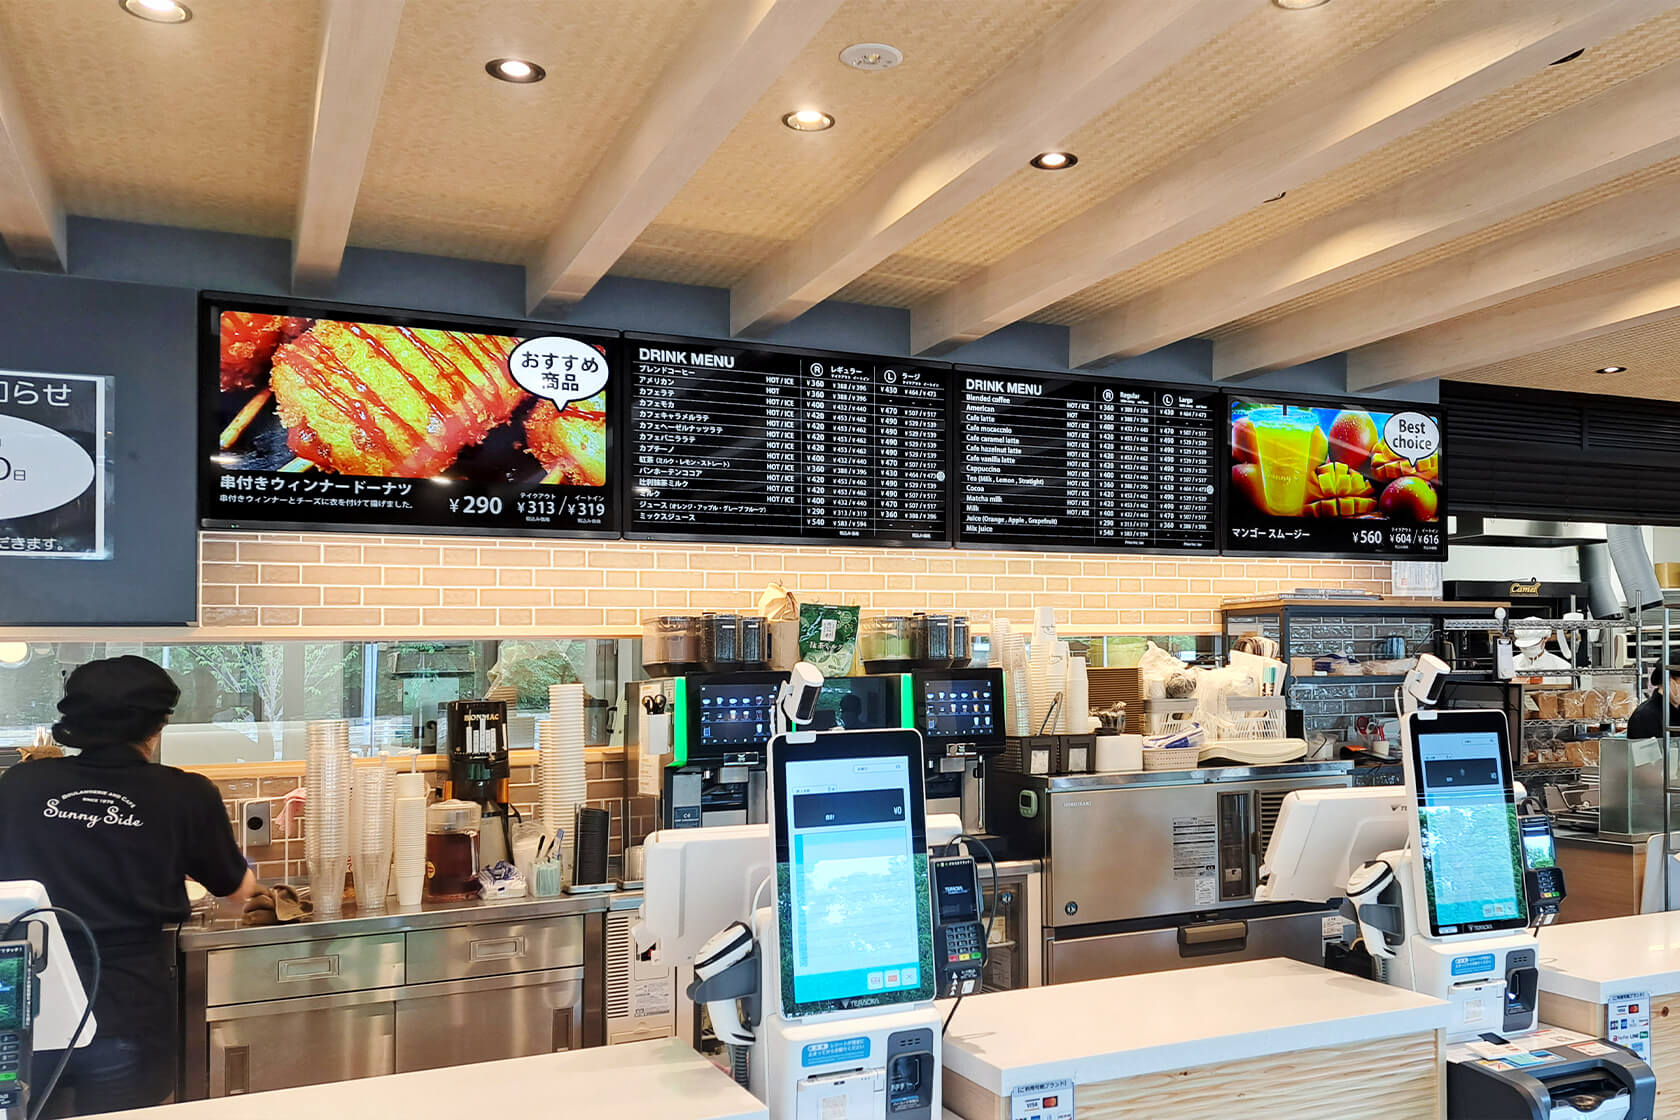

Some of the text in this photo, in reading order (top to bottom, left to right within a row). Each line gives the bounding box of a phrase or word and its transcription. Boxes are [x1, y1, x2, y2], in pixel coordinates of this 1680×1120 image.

[521, 351, 599, 373] おすすめ
[639, 348, 735, 369] DRINK MENU
[639, 365, 695, 375] ブレンドコーヒー
[831, 366, 863, 375] レギュラー
[902, 372, 920, 381] ラージ
[541, 371, 579, 392] 商品
[639, 376, 675, 386] アメリカン
[639, 387, 675, 397] カフェラテ
[766, 387, 780, 395] HOT
[966, 378, 1042, 396] DRINK MENU
[639, 399, 675, 408] カフェモカ
[966, 394, 1011, 404] Blended coffee
[966, 404, 995, 413] American
[966, 414, 980, 422] Cafe
[966, 424, 980, 432] Cafe
[1399, 419, 1426, 435] Best
[966, 434, 980, 442] Cafe
[1392, 435, 1432, 450] choice
[966, 444, 980, 452] Cafe
[966, 454, 980, 462] Cafe
[220, 475, 412, 496] 串付きウィンナードーナツ
[639, 501, 668, 510] ジュース
[43, 798, 144, 828] Sunny Side
